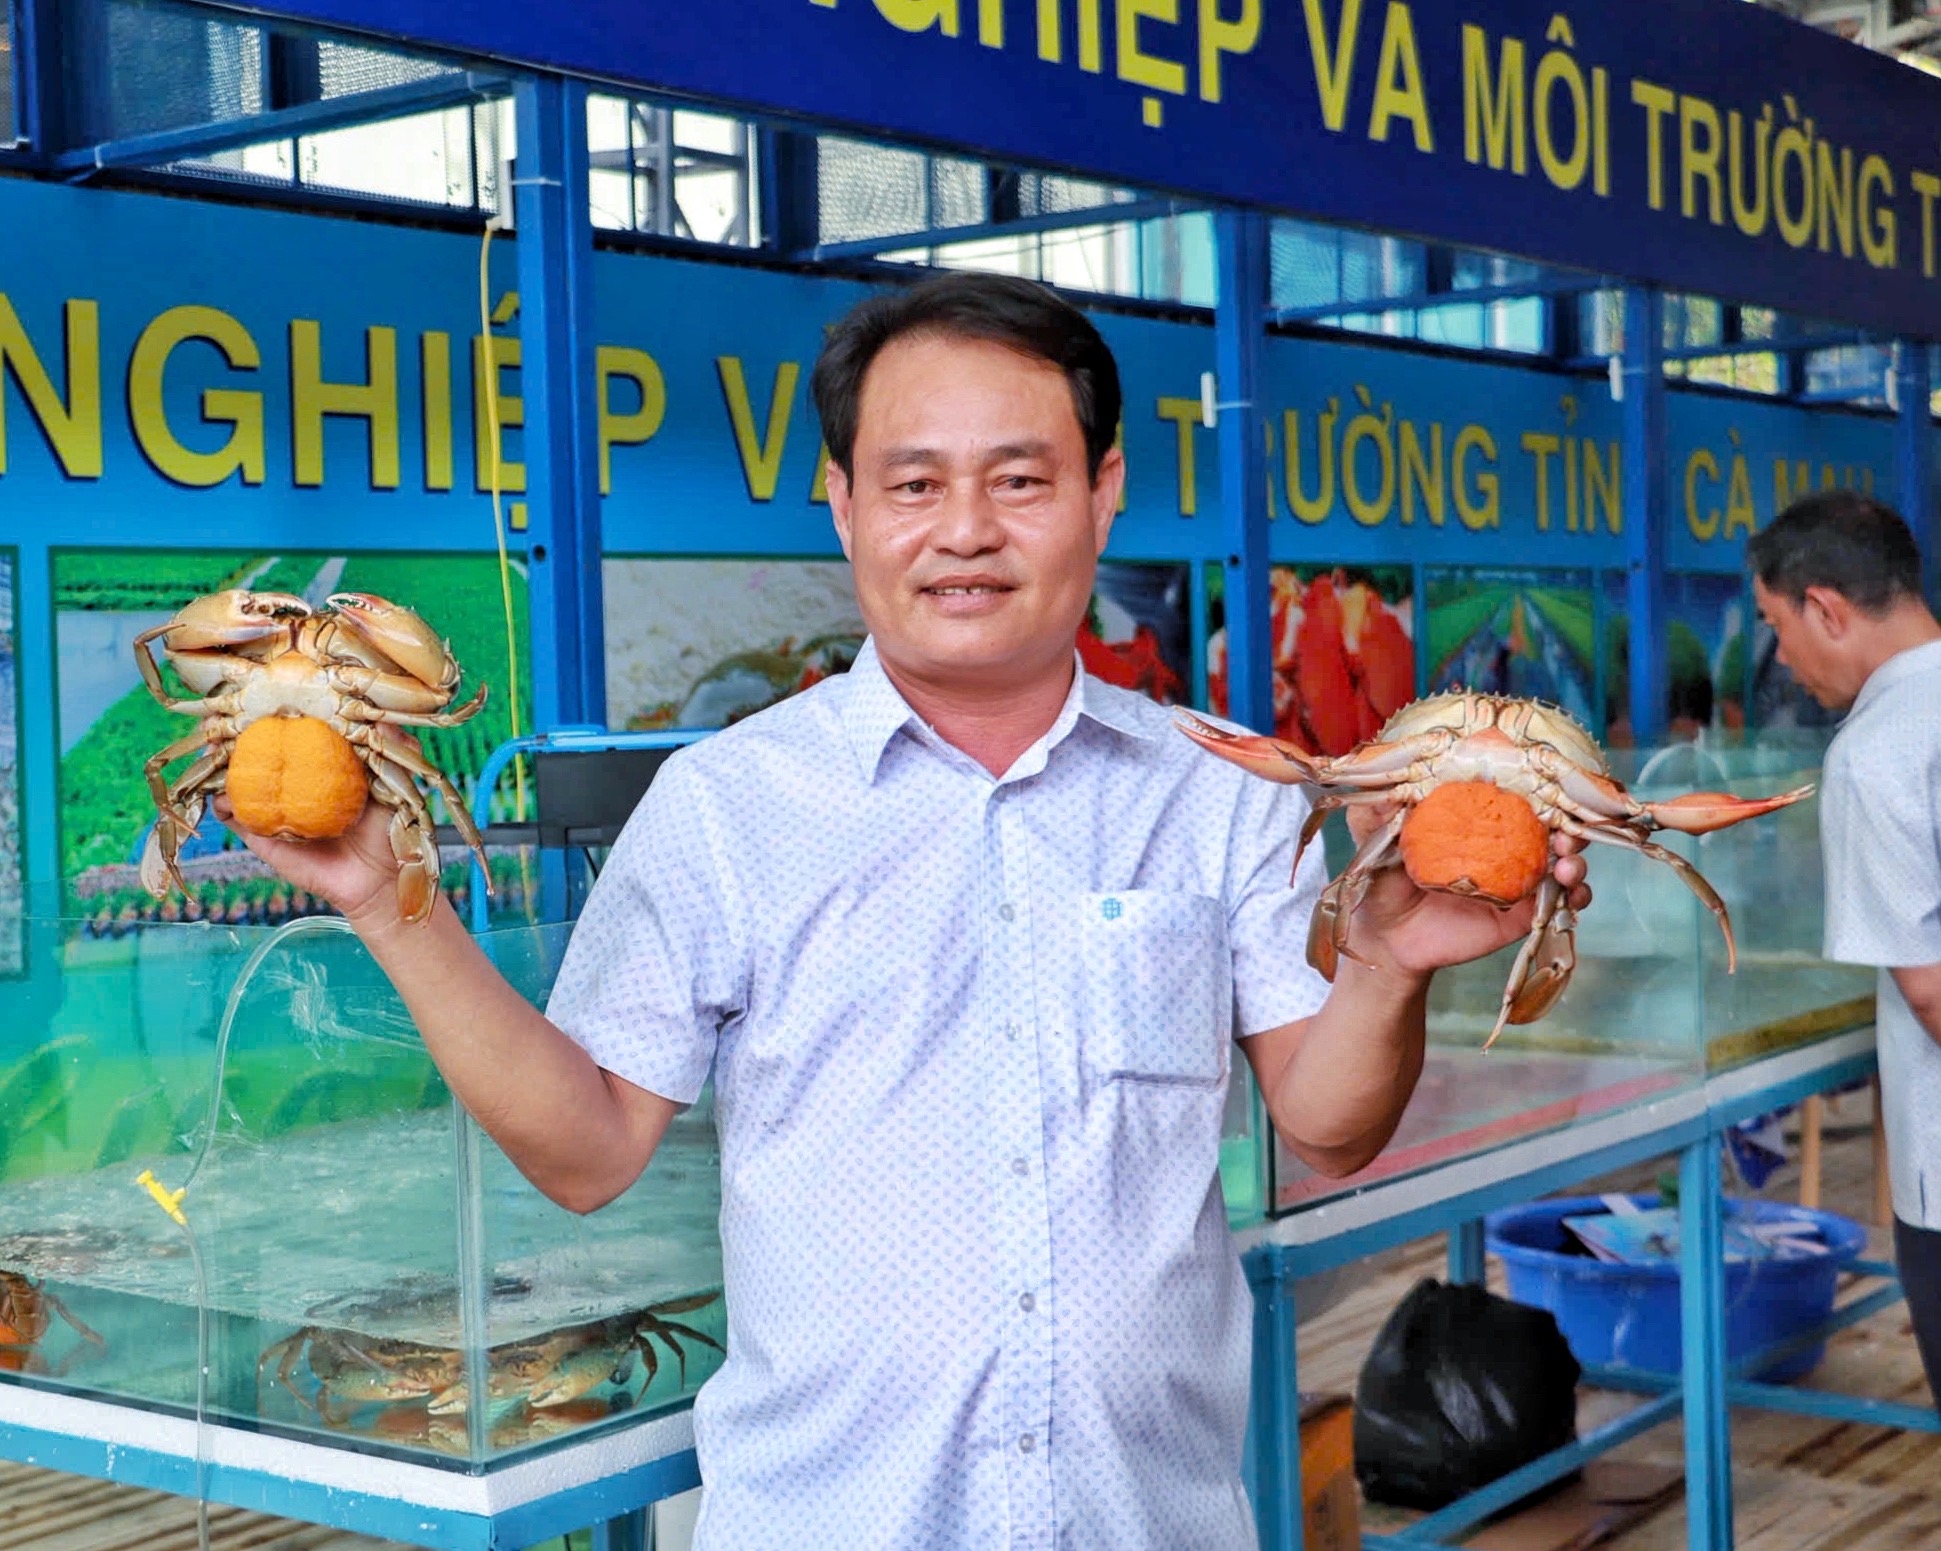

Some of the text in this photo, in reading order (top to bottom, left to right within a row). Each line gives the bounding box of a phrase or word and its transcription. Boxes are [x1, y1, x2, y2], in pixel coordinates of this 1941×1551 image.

[1462, 14, 1610, 197] MÔI
[1631, 79, 1897, 269] TRƯỜNG
[717, 355, 832, 501] V
[1157, 383, 1500, 530] TƯỜNG
[1522, 395, 1622, 535] TỈN
[1685, 428, 1759, 541] CÀ
